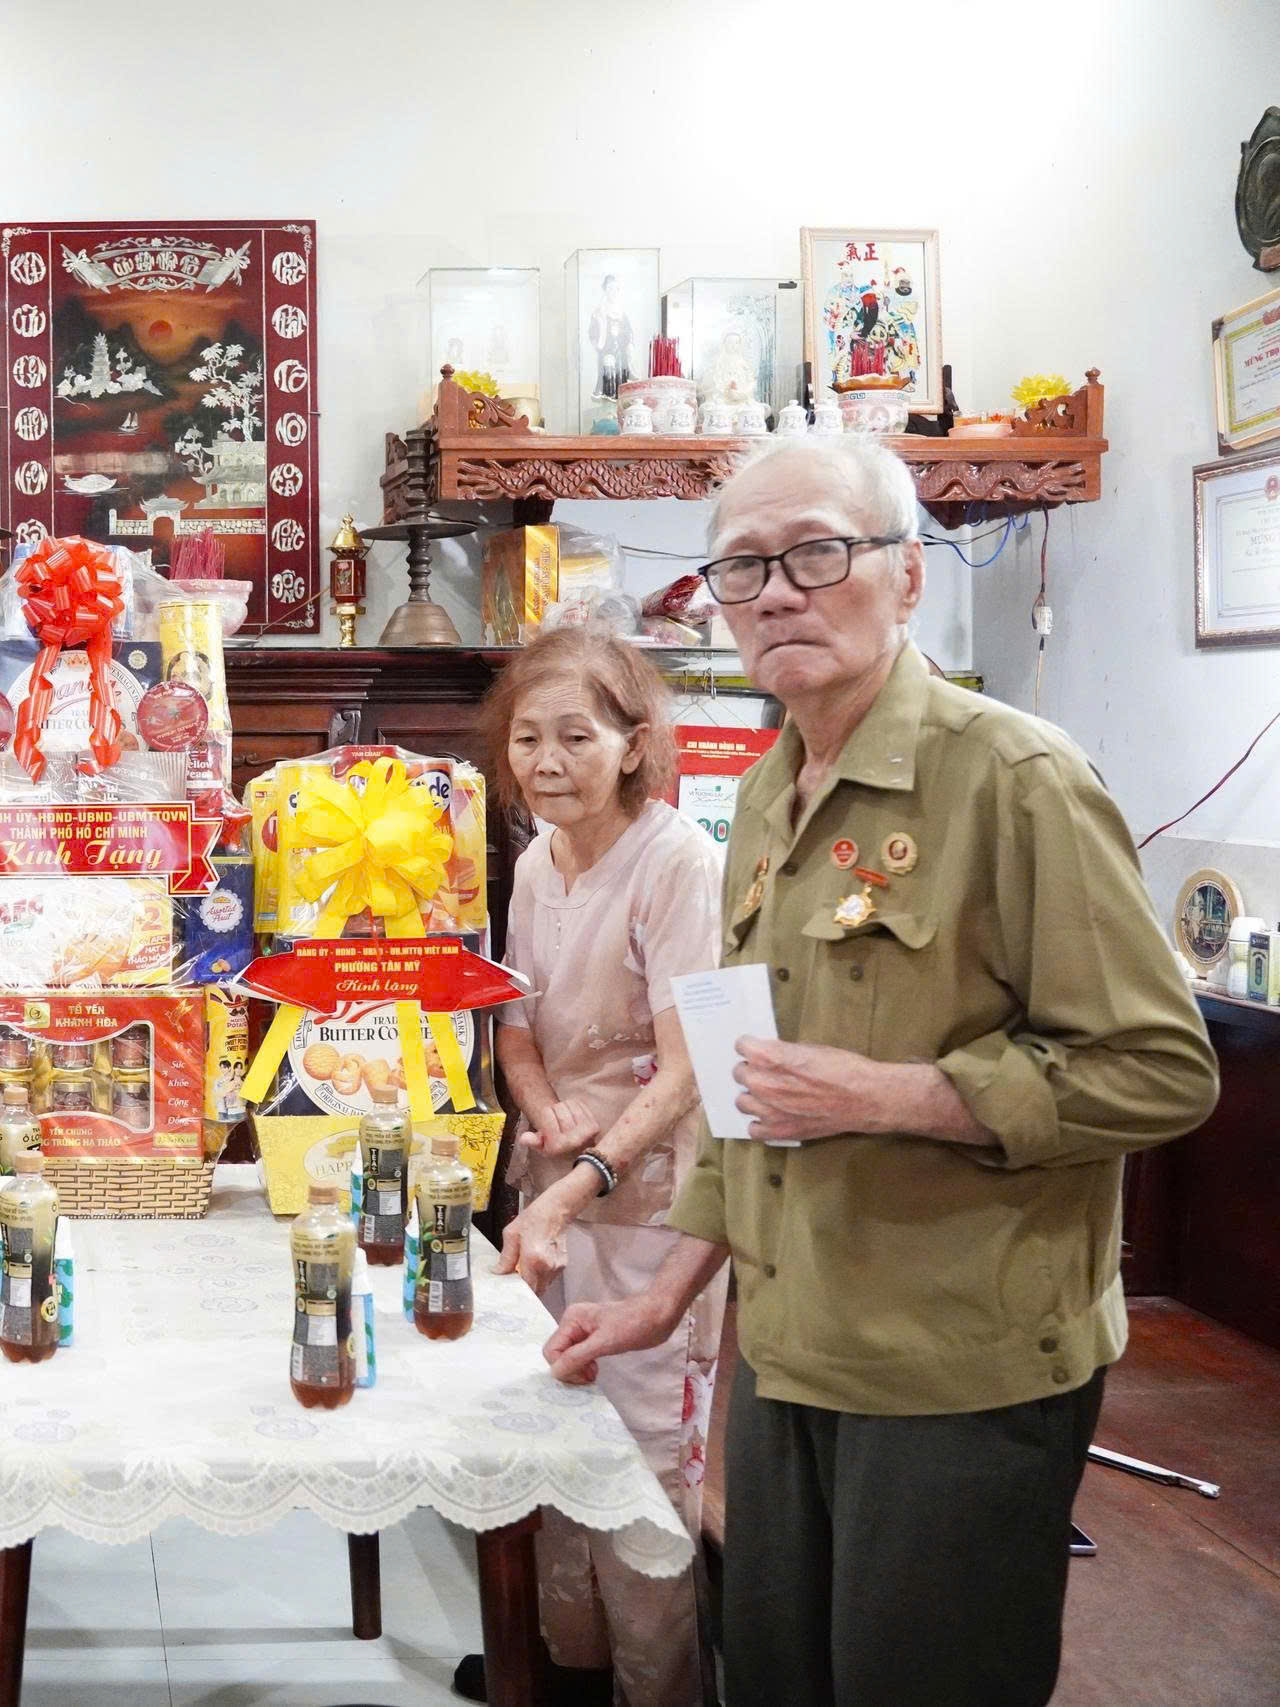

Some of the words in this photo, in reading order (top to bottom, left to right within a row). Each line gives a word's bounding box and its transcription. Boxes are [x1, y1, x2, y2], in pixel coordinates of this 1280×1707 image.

[10, 825, 47, 840] THÀNH
[50, 823, 72, 839] PHỐ
[118, 826, 148, 839] MINH
[85, 839, 164, 871] Tặng
[207, 904, 237, 916] Assorted
[213, 912, 232, 924] Fruit
[423, 945, 440, 956] VIỆT
[441, 946, 459, 955] NAM
[334, 960, 379, 973] PHƯỜNG
[380, 960, 401, 973] TÂN
[335, 979, 381, 993] Kính
[85, 1001, 105, 1015] YẾN
[55, 1016, 93, 1028] KHÁNH
[95, 1016, 118, 1028] HÒA
[319, 1026, 375, 1042] BUTTER
[320, 1091, 350, 1114] ORIGINAL
